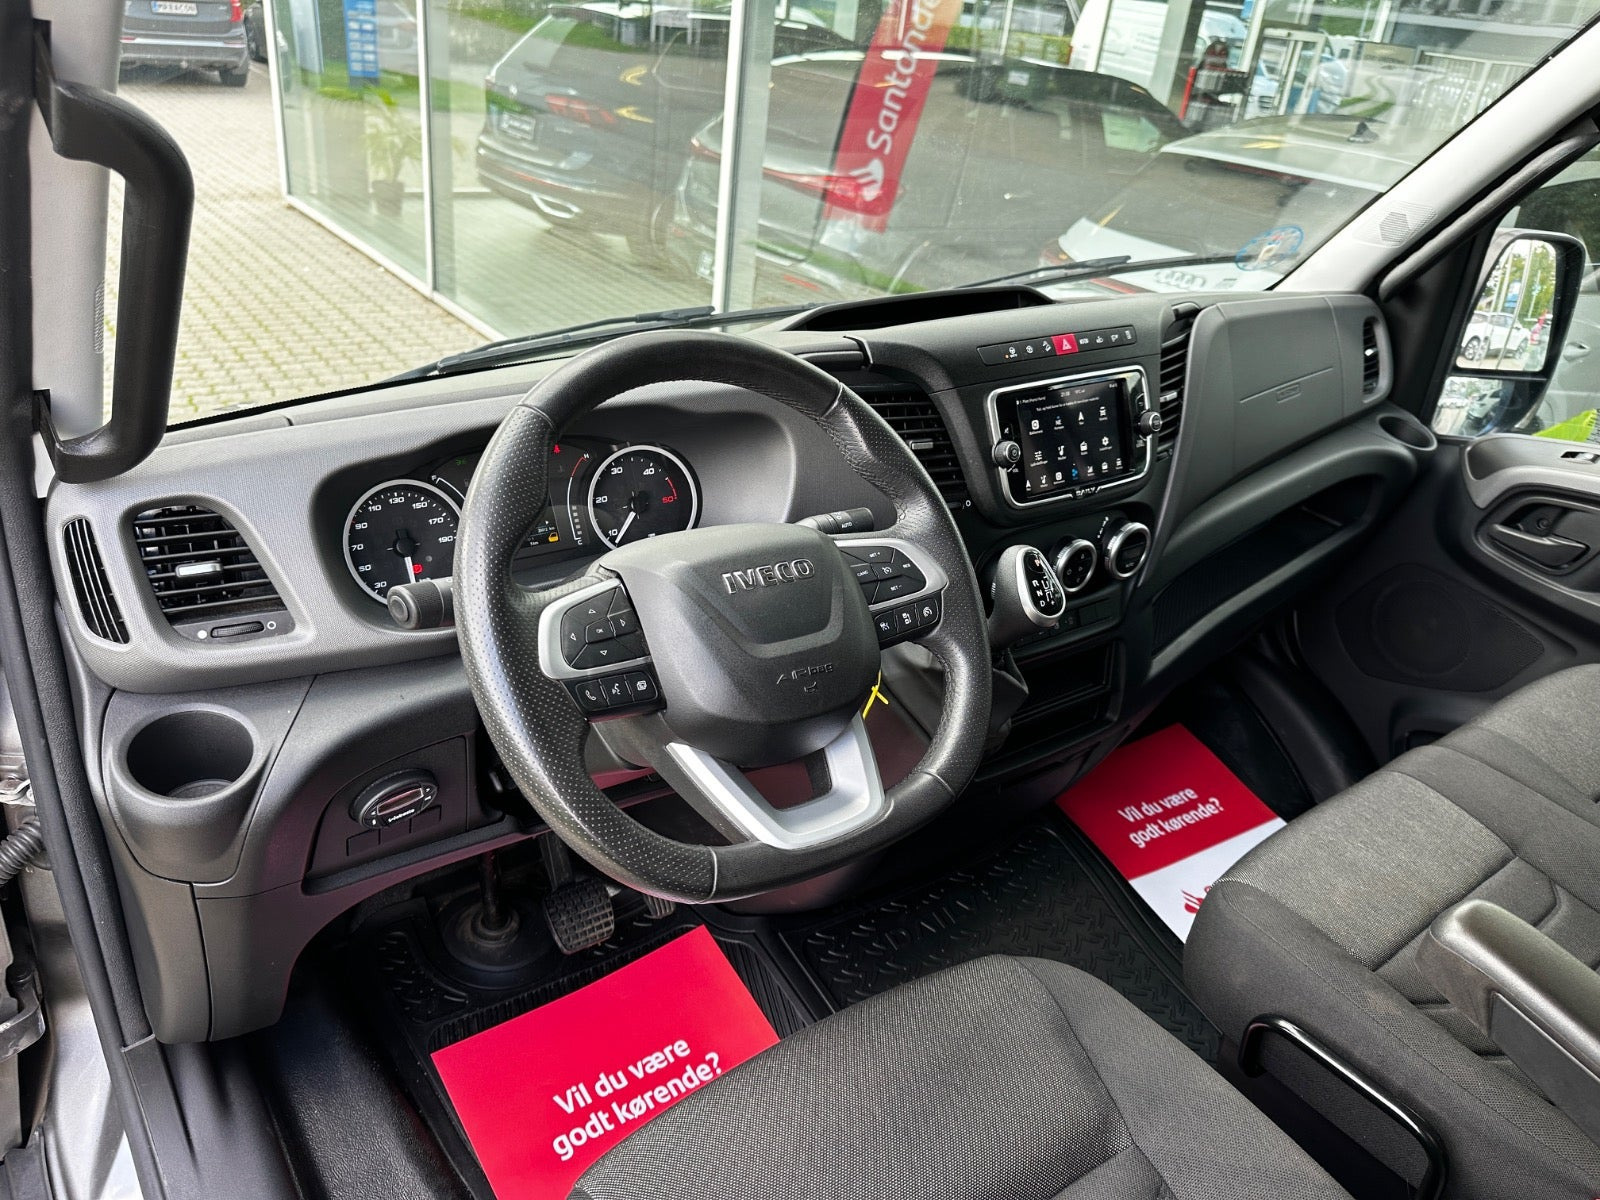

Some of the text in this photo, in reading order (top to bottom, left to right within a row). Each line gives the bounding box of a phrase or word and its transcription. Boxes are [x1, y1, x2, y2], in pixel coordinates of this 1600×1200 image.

[611, 466, 623, 475] 30
[643, 467, 655, 475] 40
[388, 496, 405, 505] 130
[595, 495, 608, 504] 20
[367, 504, 382, 512] 110
[411, 501, 428, 510] 150
[428, 516, 444, 525] 170
[355, 522, 368, 530] 90
[608, 528, 618, 537] 10
[438, 535, 453, 543] 190
[351, 543, 364, 551] 70
[358, 564, 372, 572] 50
[721, 558, 815, 595] IVECO
[374, 581, 387, 589] 30
[1032, 579, 1039, 587] R
[1036, 589, 1043, 597] N
[1117, 788, 1198, 823] Vil du være
[1129, 797, 1224, 849] godt kørende?
[552, 1039, 691, 1115] Vil du være
[552, 1051, 722, 1162] godt kørende?
